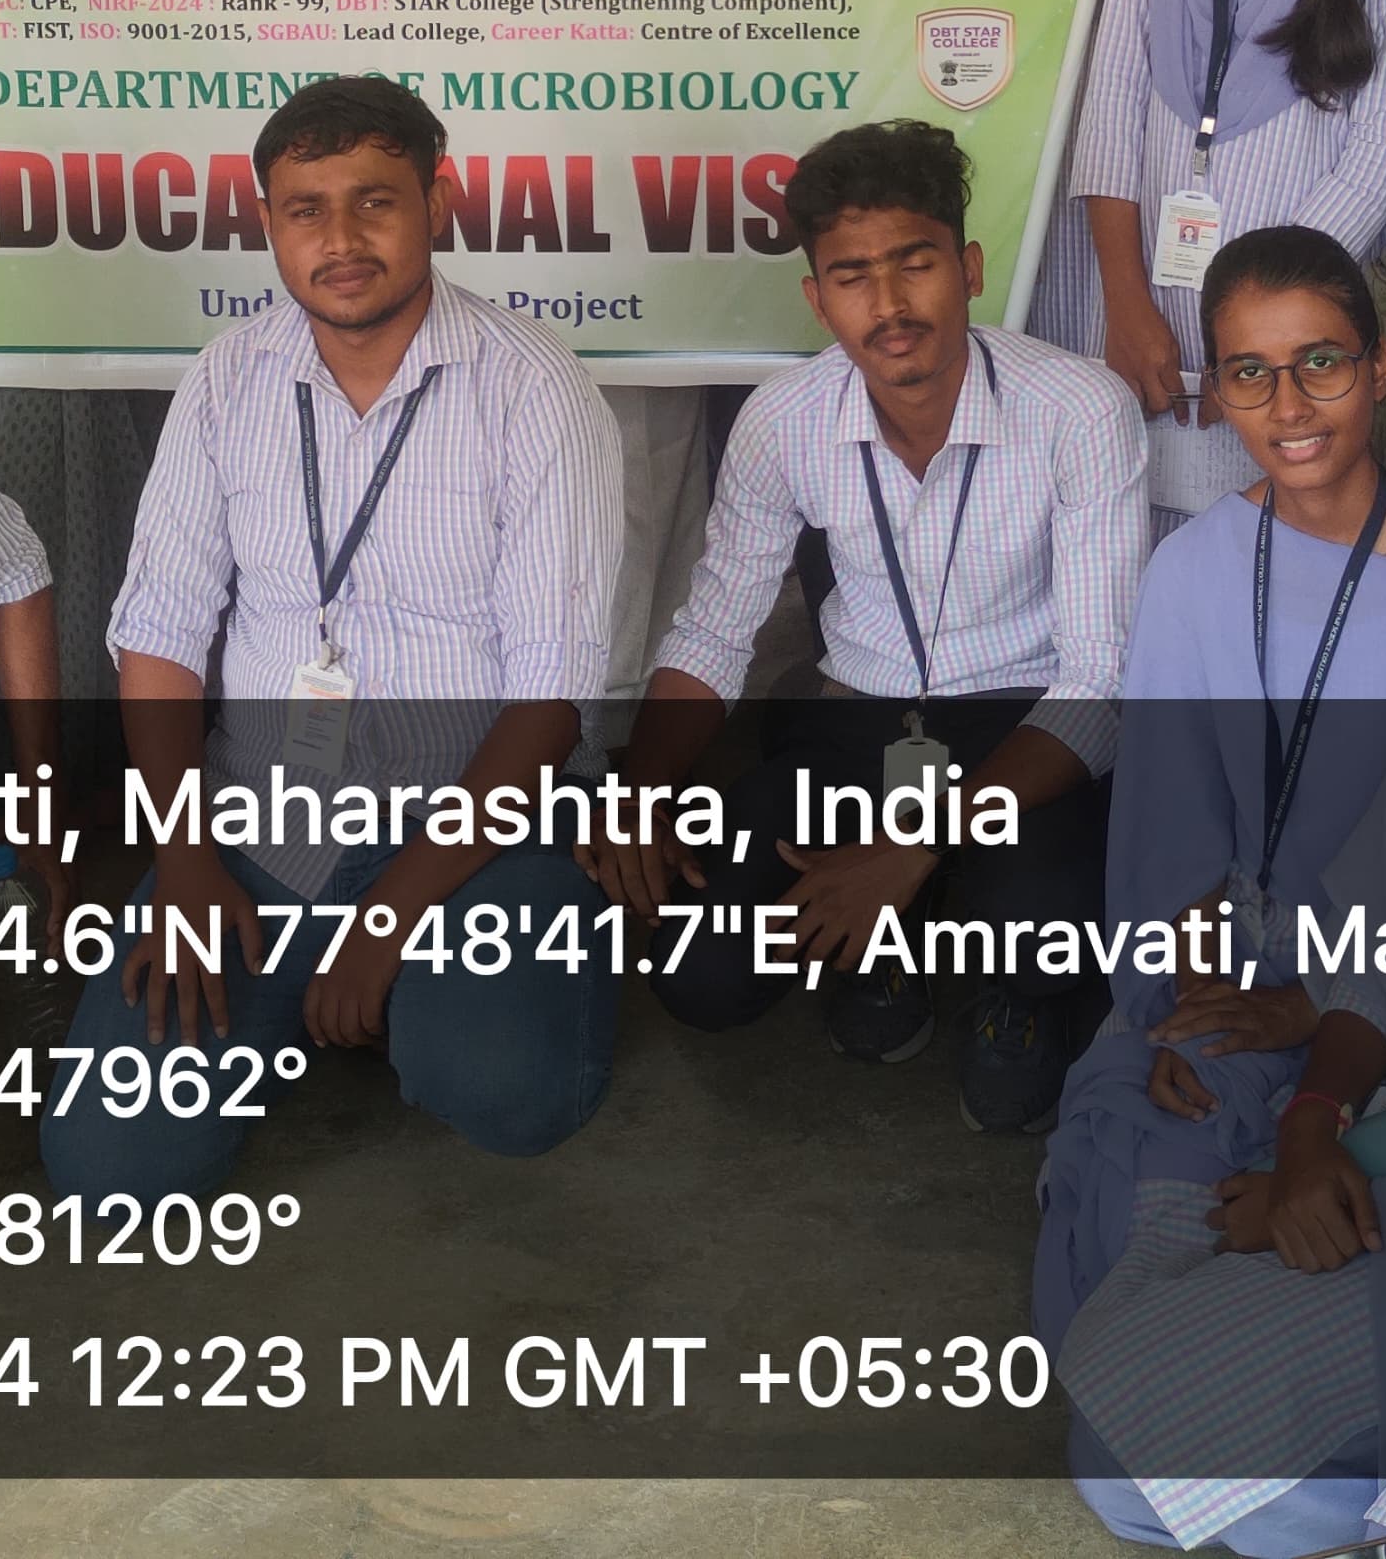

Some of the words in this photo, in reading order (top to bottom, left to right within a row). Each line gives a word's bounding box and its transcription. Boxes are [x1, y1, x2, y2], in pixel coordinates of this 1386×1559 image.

[23, 22, 74, 41] FIST,
[79, 22, 121, 40] ISO:
[127, 23, 252, 43] 9001-2015,
[257, 23, 337, 41] SGBAU:
[343, 22, 395, 41] Lead
[401, 22, 485, 45] College,
[491, 23, 565, 41] Career
[570, 23, 634, 41] Katta:
[640, 22, 712, 40] Centre
[718, 22, 741, 40] of
[746, 22, 860, 40] Excellence
[929, 26, 960, 38] DBT
[963, 26, 1002, 38] STAR
[932, 37, 999, 49] COLLEGE
[441, 71, 860, 111] MICROBIOLOGY
[507, 291, 643, 327] Project
